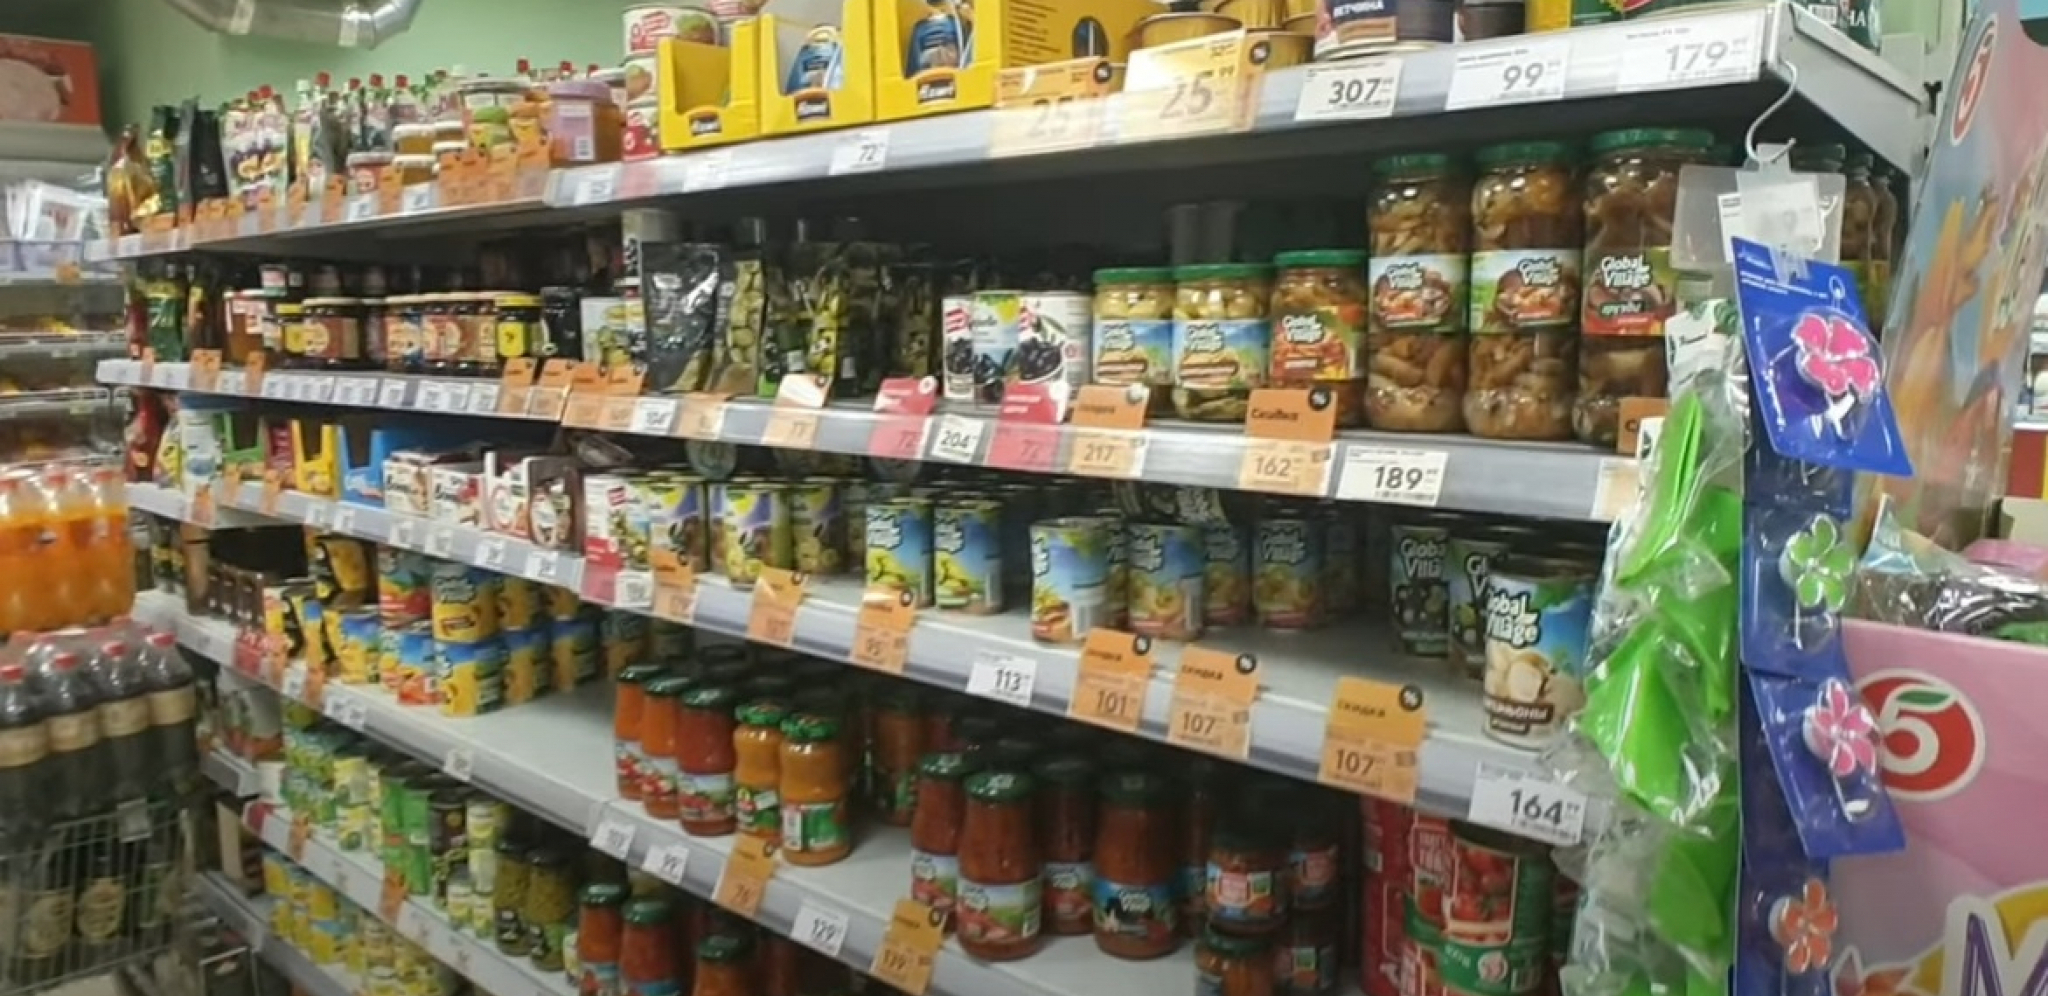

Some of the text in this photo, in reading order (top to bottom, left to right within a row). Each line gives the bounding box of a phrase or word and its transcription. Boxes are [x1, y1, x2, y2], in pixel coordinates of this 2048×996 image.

[1665, 41, 1729, 72] 179
[1503, 62, 1544, 91] 99
[1328, 78, 1381, 104] 307
[940, 430, 970, 449] 204
[1083, 443, 1115, 463] 217
[1255, 456, 1292, 477] 162
[1374, 466, 1423, 490] 189
[994, 664, 1022, 692] 113
[1097, 690, 1128, 716] 101
[1183, 711, 1216, 735] 107
[1336, 749, 1374, 776] 107
[1510, 789, 1563, 825] 164
